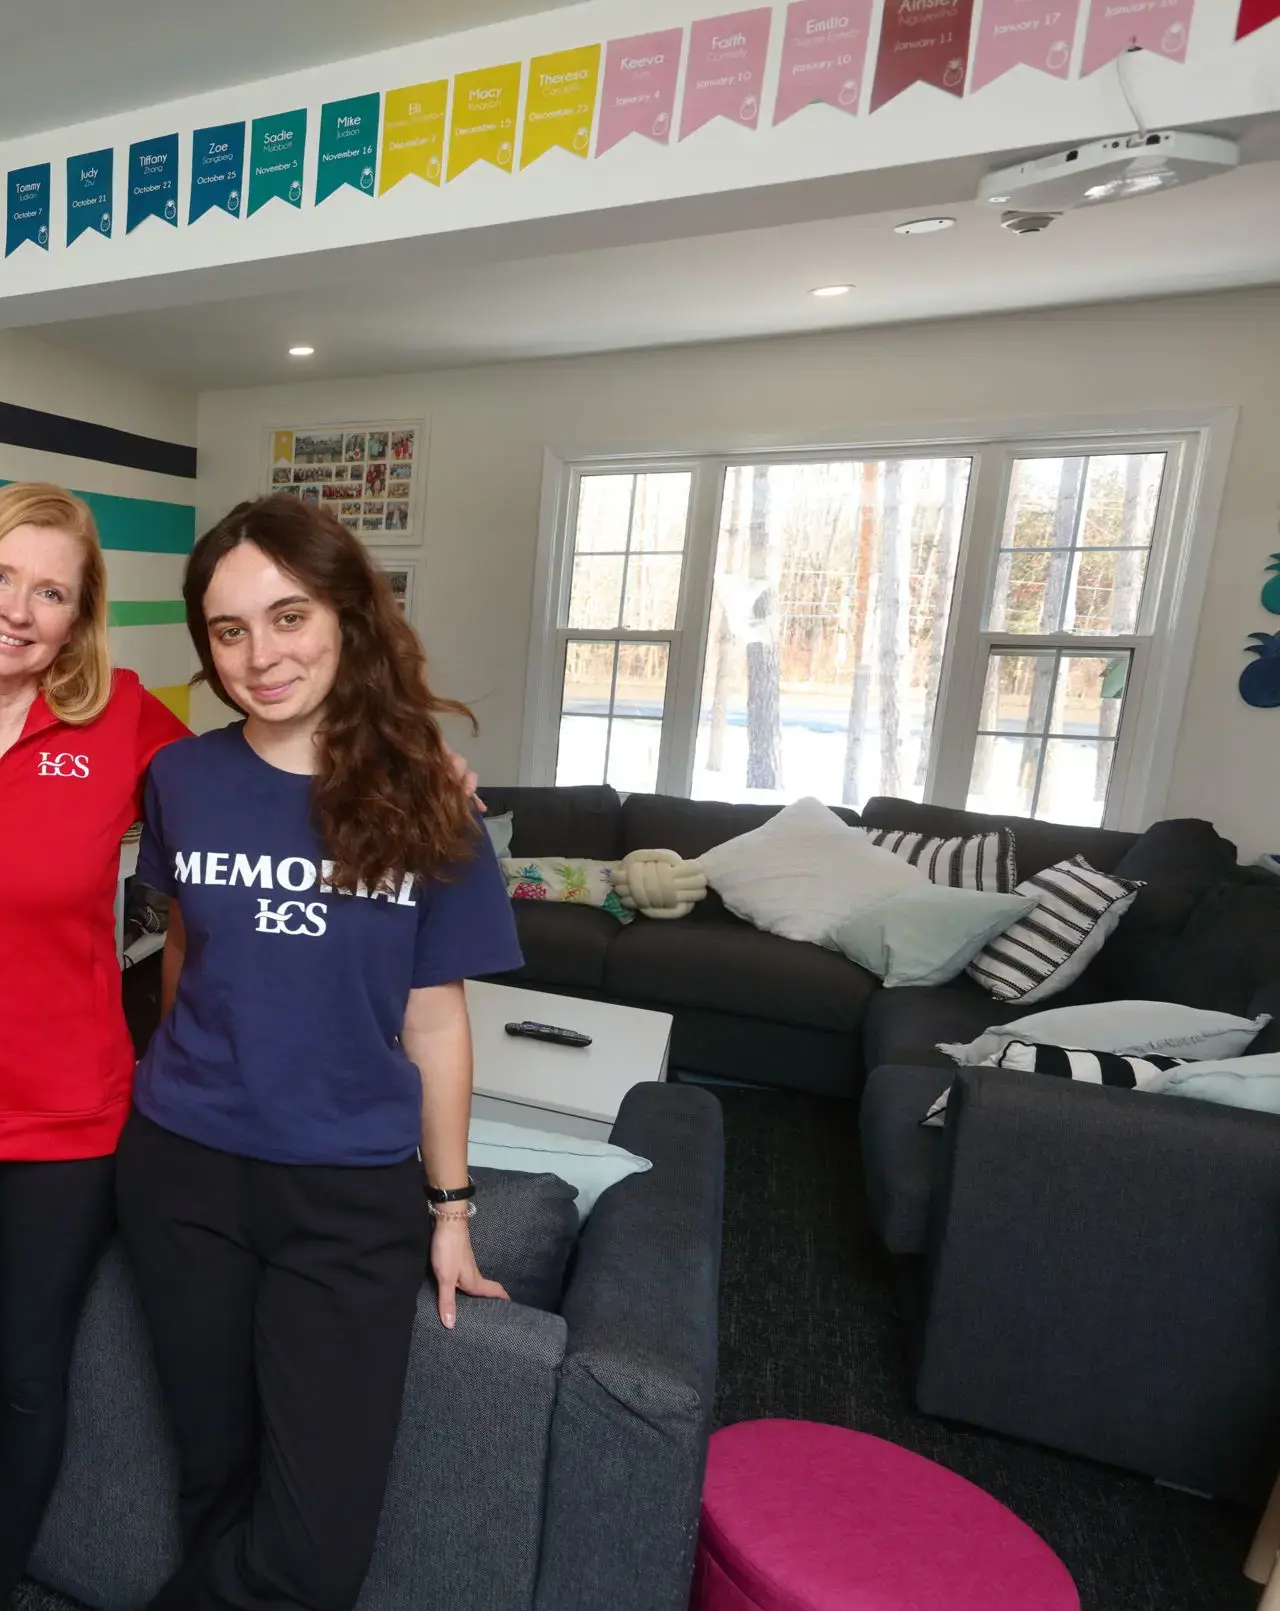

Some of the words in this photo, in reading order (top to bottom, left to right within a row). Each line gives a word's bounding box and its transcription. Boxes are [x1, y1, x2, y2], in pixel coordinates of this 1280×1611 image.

[994, 20, 1040, 36] January
[1044, 12, 1061, 26] 17
[711, 32, 746, 50] Faith
[940, 31, 953, 44] 11
[620, 54, 664, 70] Keeva
[836, 53, 852, 66] 10
[540, 70, 589, 87] Theresa
[696, 76, 735, 89] January
[737, 70, 752, 82] 10
[469, 87, 503, 102] Macy
[654, 89, 660, 99] 4
[337, 115, 362, 129] Mike
[263, 129, 294, 144] Sadie
[208, 142, 228, 154] Zoe
[322, 149, 360, 162] November
[362, 145, 373, 155] 16
[139, 154, 168, 167] Tiffany
[80, 167, 99, 181] Judy
[143, 165, 163, 175] Zhang
[255, 163, 291, 176] November
[196, 174, 225, 185] October
[227, 171, 237, 180] 25
[16, 182, 41, 194] Tommy
[133, 184, 161, 195] October
[162, 181, 172, 189] 22
[72, 197, 97, 208] October
[98, 195, 106, 203] 21
[13, 211, 37, 220] October
[37, 752, 89, 778] LCS
[254, 898, 328, 936] LCS
